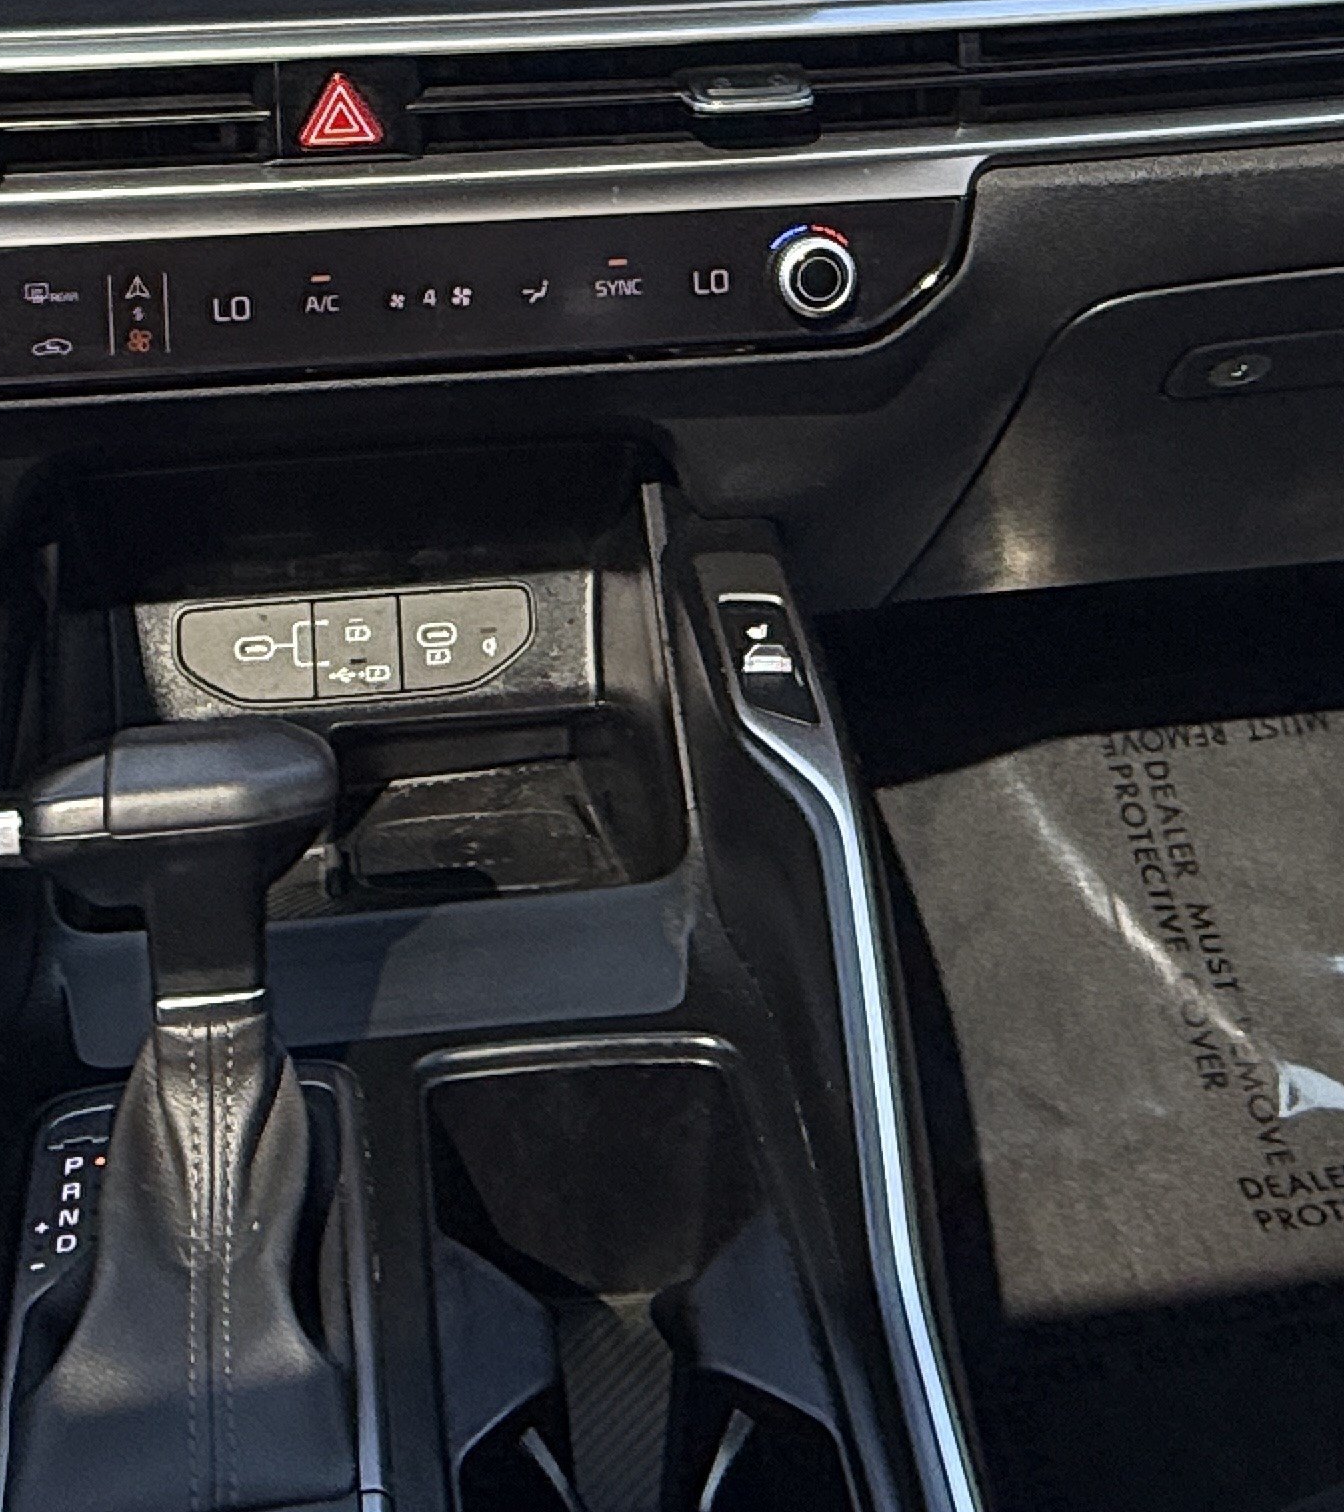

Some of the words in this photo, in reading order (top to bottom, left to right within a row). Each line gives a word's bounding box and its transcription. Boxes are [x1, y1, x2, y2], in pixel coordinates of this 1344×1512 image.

[593, 277, 644, 299] SYNC
[692, 267, 730, 296] LO
[305, 293, 341, 315] A/C
[422, 288, 438, 307] 4
[213, 296, 252, 323] LO
[1108, 763, 1192, 953] PROTECTIVE
[1142, 759, 1201, 879] DEALER
[1185, 903, 1239, 992] MUST
[63, 1156, 84, 1176] P
[58, 1208, 80, 1227] N
[56, 1234, 78, 1254] D
